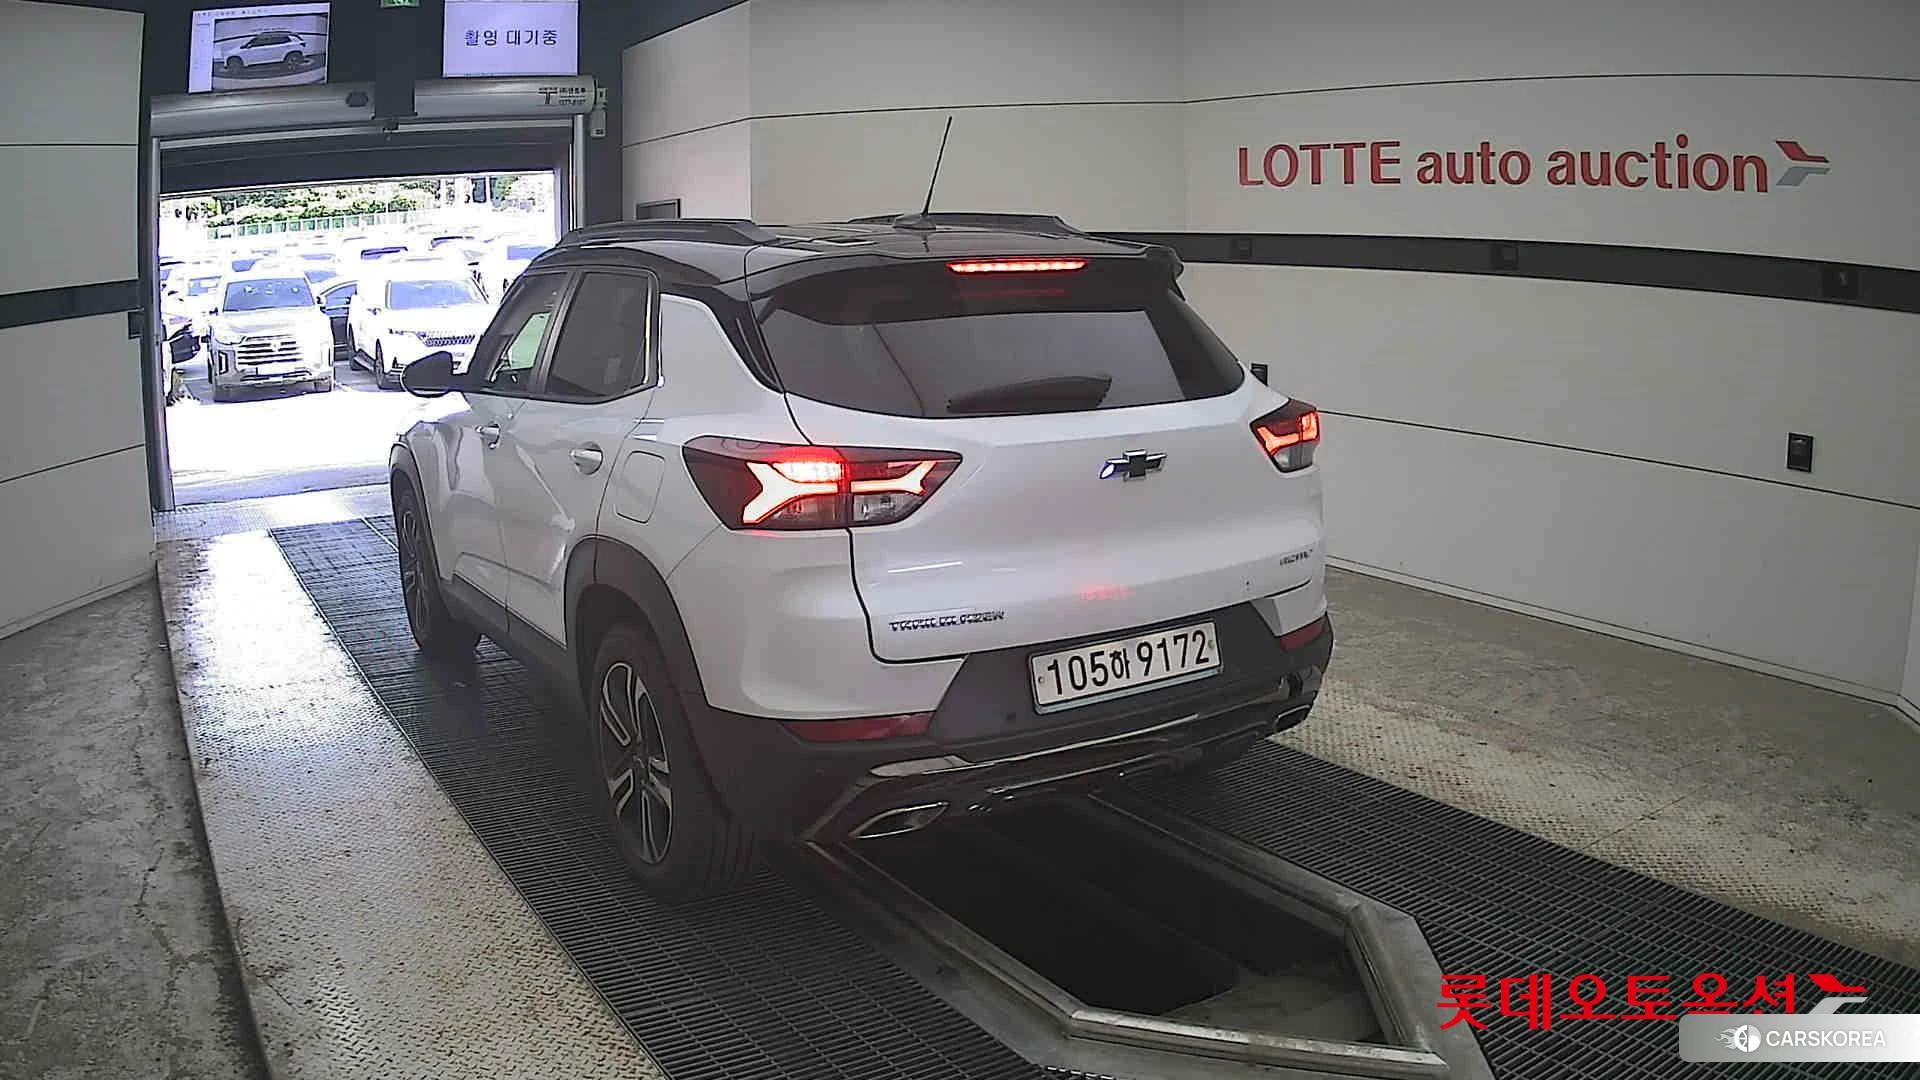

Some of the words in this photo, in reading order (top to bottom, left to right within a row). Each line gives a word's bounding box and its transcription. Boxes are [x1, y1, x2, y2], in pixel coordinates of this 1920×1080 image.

[506, 30, 558, 46] 대기중
[1239, 141, 1400, 187] LOTTE
[1416, 142, 1531, 185] auto
[1547, 134, 1768, 193] auction
[1048, 648, 1130, 695] 105하
[1136, 630, 1209, 677] 9172
